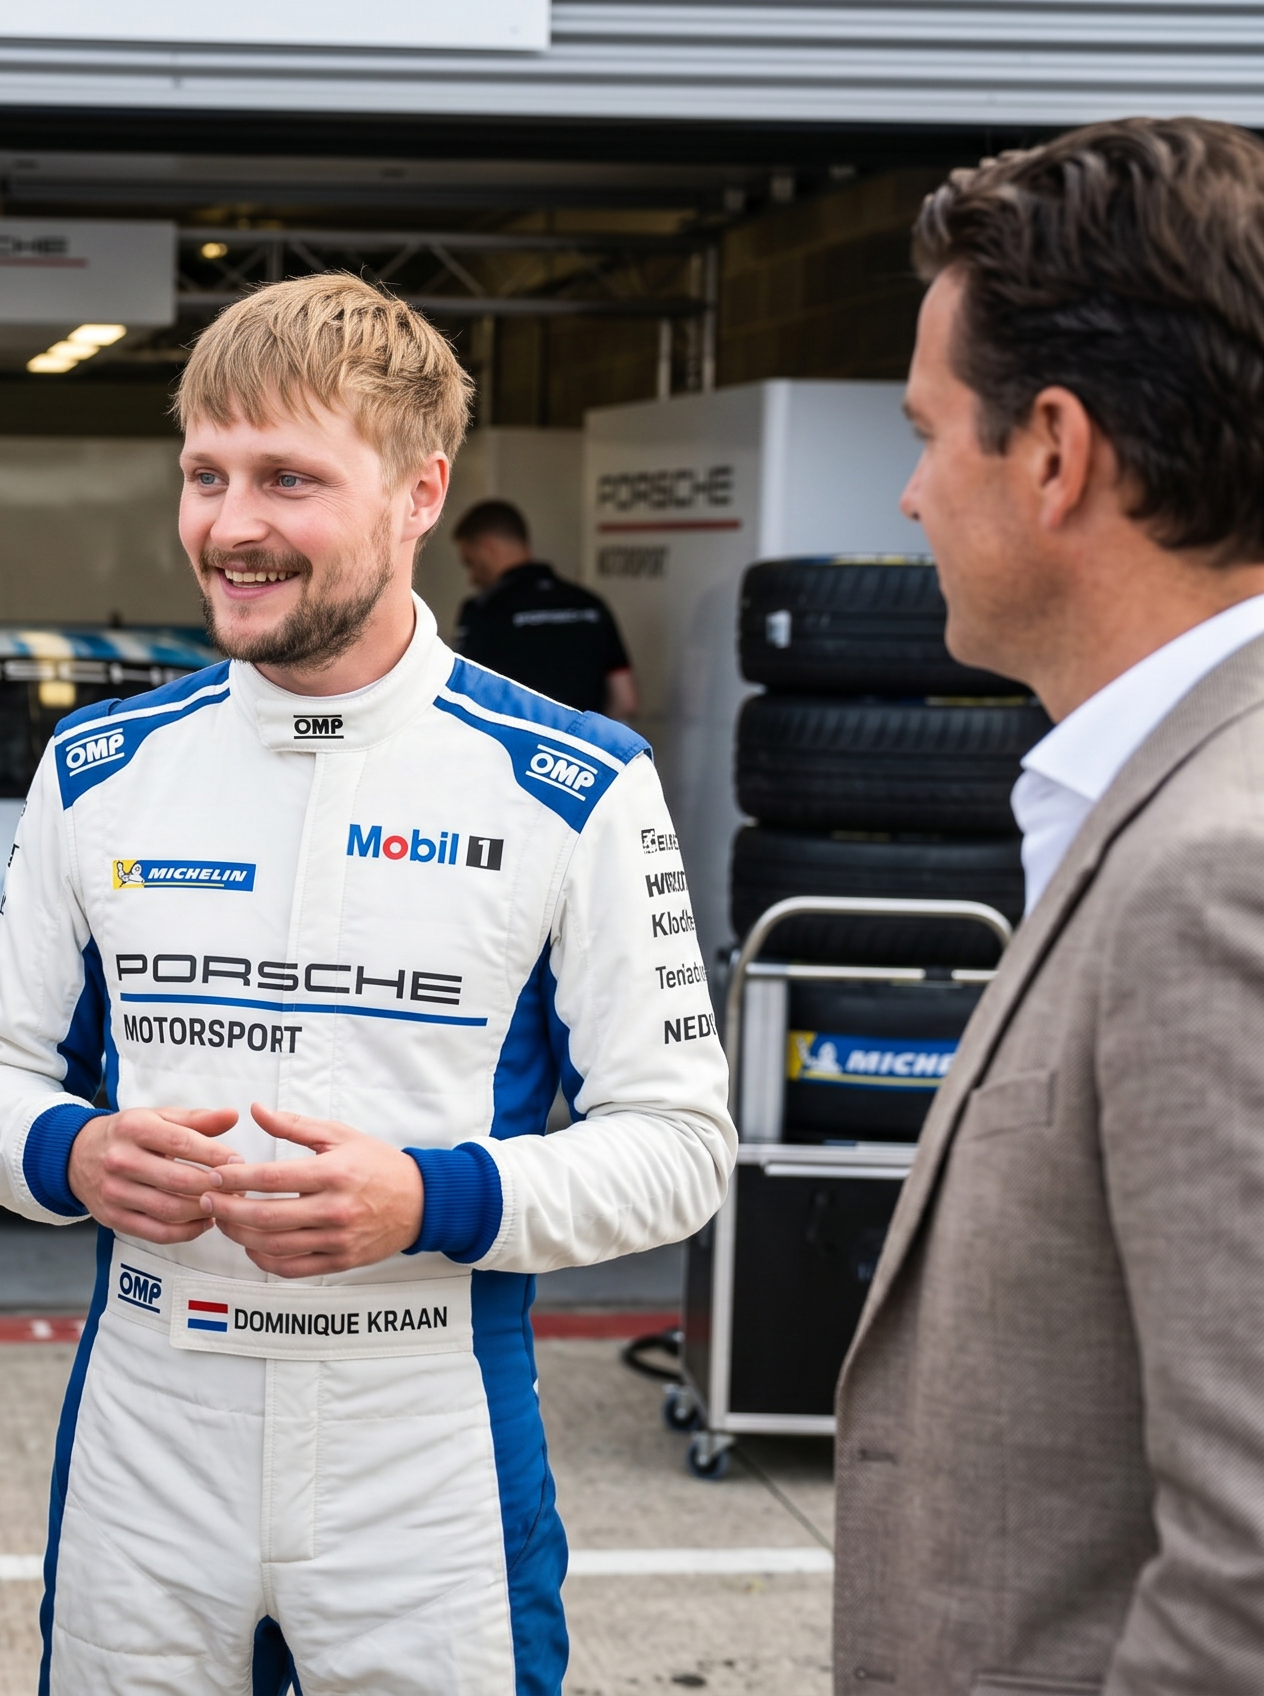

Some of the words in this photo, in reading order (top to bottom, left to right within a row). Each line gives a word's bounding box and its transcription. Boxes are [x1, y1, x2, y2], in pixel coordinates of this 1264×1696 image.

[294, 718, 344, 735] OMP
[65, 733, 125, 770] OMP
[530, 752, 596, 791] OMP
[346, 823, 460, 866] Mobil
[147, 867, 248, 882] MICHELIN
[115, 953, 463, 1006] PORSCHE
[123, 1013, 303, 1054] MOTORSPORT
[118, 1271, 162, 1305] OMP
[234, 1308, 360, 1337] DOMINIQUE
[367, 1306, 449, 1334] KRAAN
